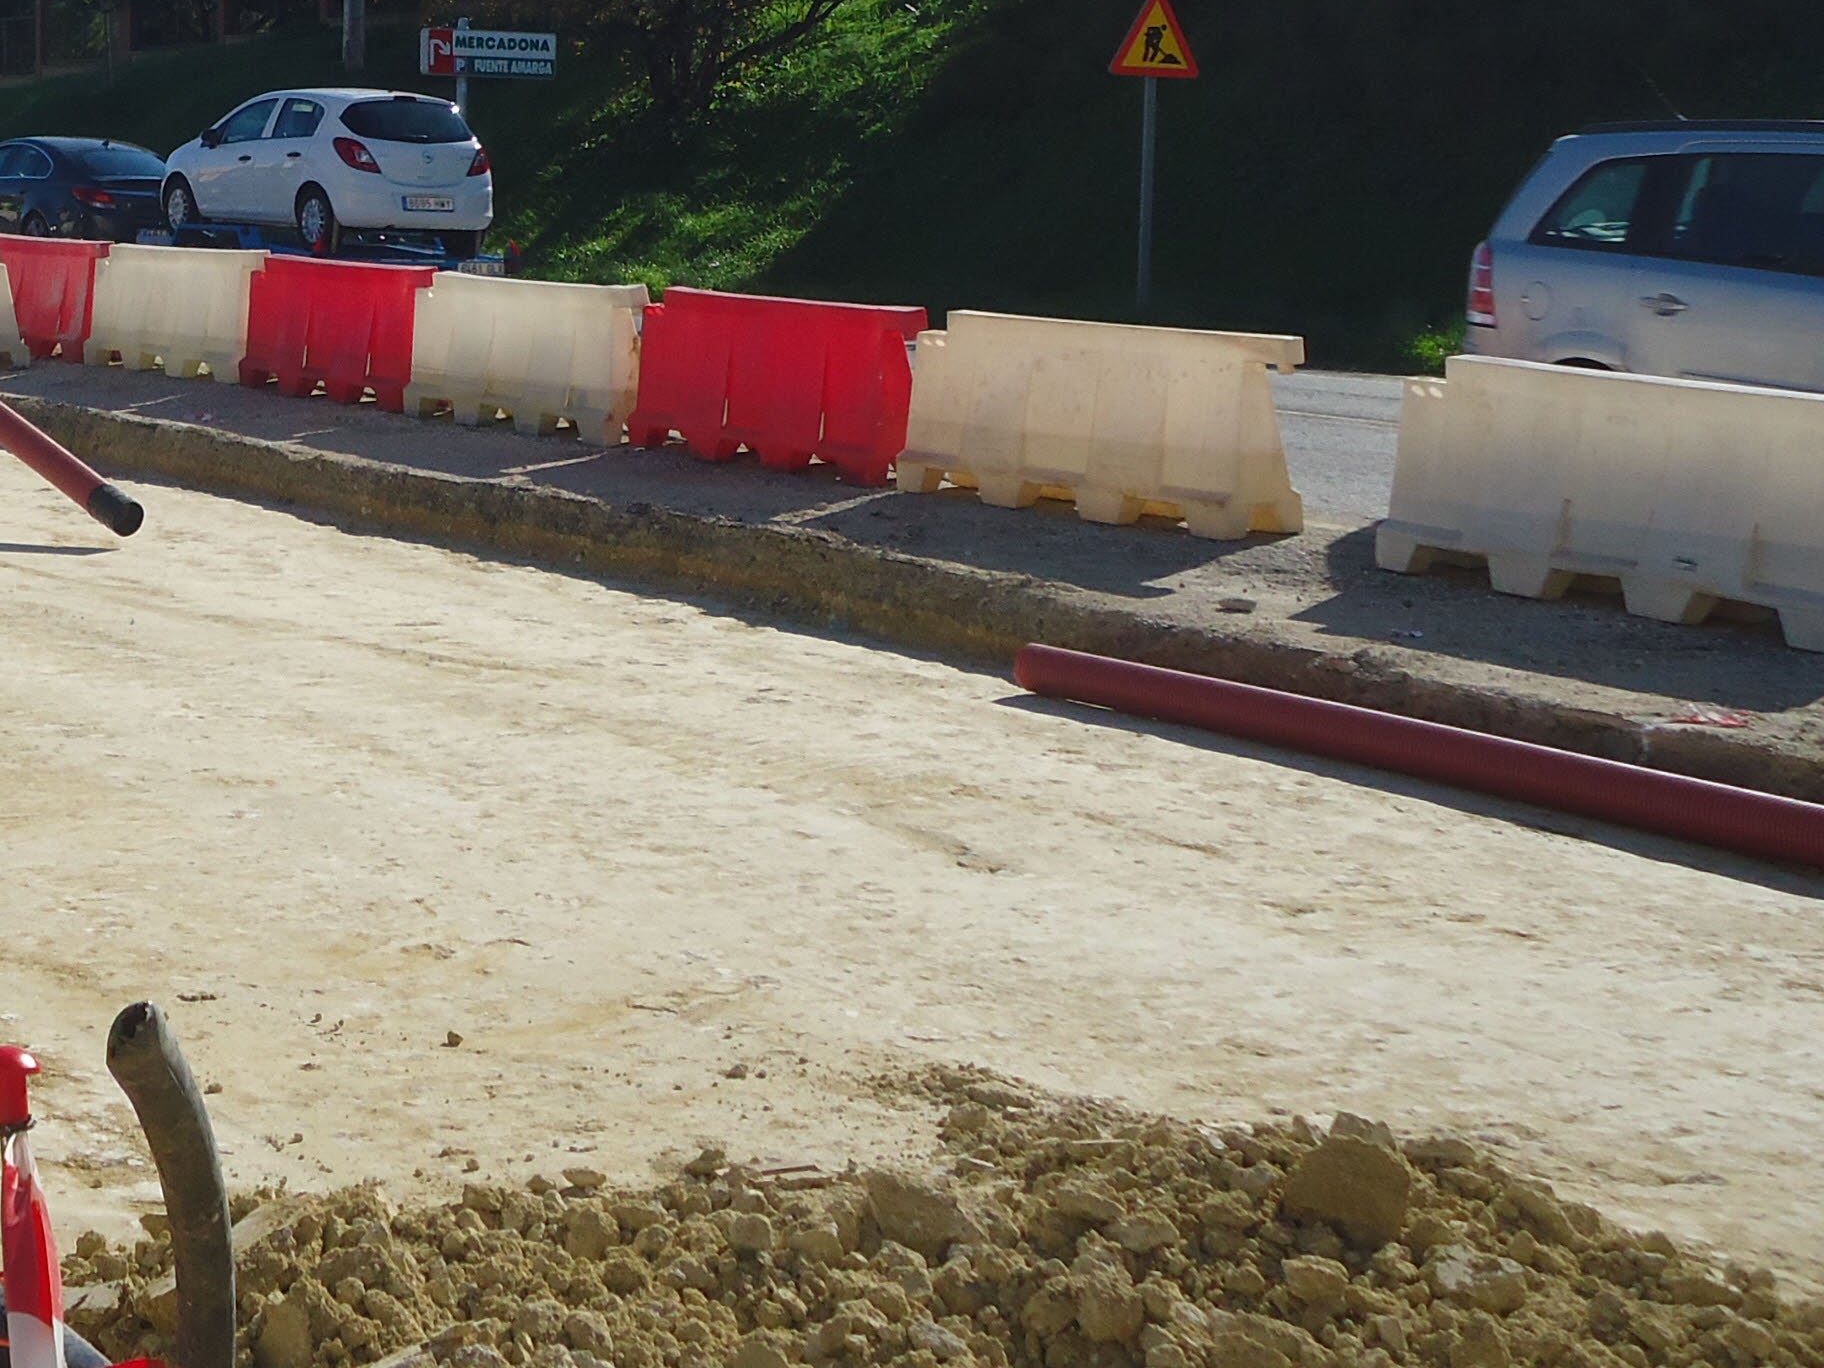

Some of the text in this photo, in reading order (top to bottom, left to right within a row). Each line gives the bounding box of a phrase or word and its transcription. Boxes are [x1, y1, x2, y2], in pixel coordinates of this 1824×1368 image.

[454, 35, 550, 52] MERCADONA
[475, 59, 509, 73] FUENTE
[510, 60, 553, 75] AMARGA
